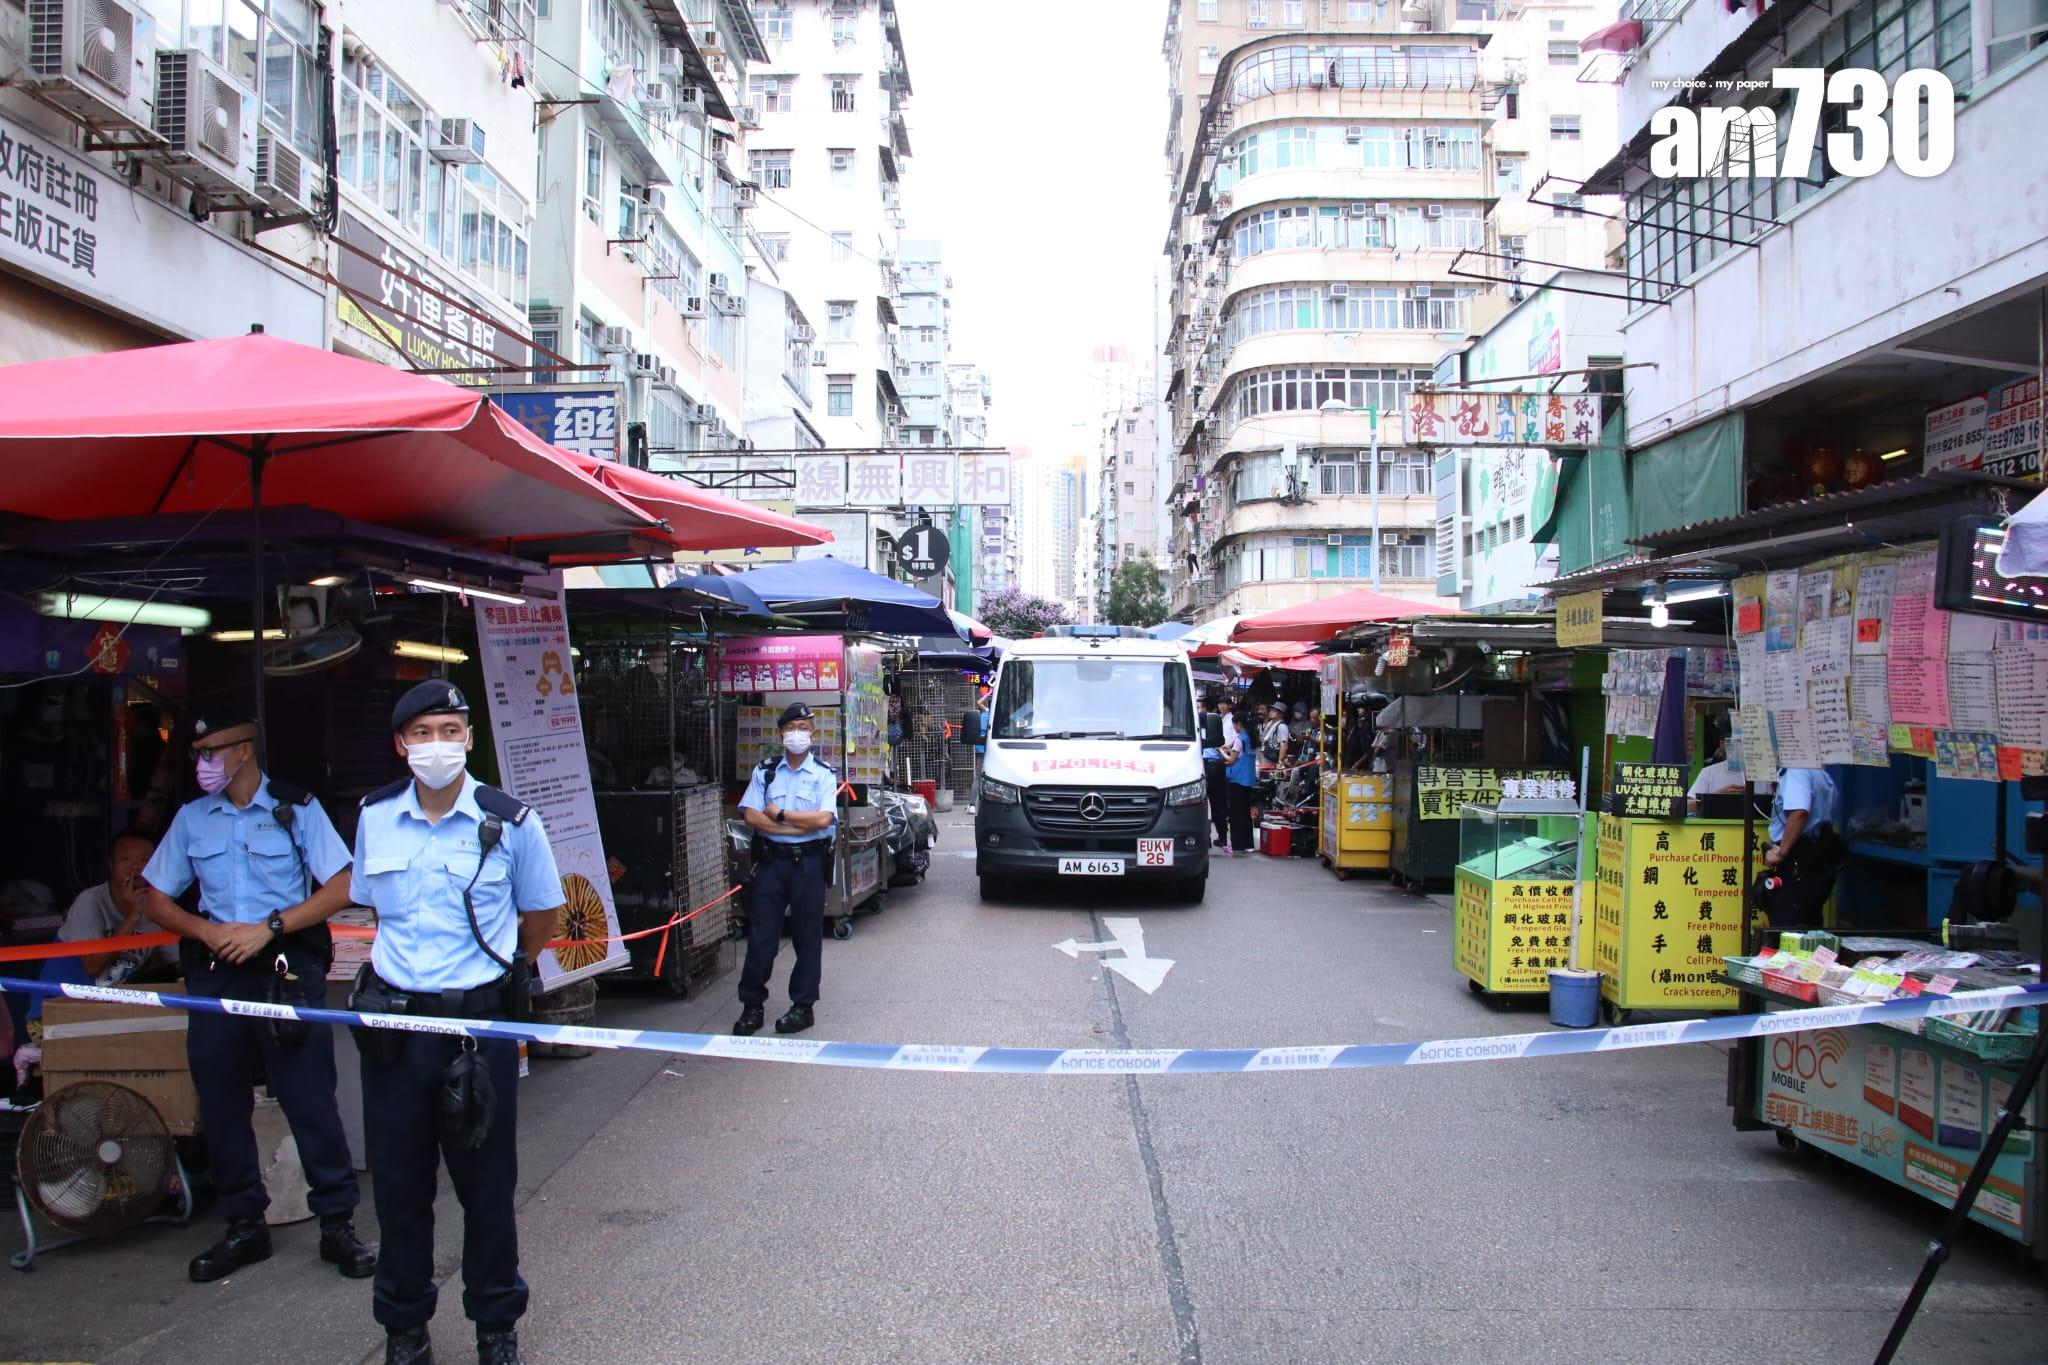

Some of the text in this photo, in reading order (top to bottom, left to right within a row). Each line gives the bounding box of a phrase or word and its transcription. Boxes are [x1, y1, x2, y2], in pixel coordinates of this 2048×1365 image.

[406, 331, 441, 367] LUCKY
[1058, 758, 1134, 770] POLICE
[1502, 779, 1576, 799] 專業維修
[1140, 841, 1171, 852] EUKW
[1147, 853, 1165, 865] 26
[1650, 853, 1691, 863] Purchase
[1692, 853, 1709, 863] Cell
[1711, 853, 1739, 863] Phone
[1064, 859, 1120, 873] AM 6163
[1693, 888, 1738, 899] Tempered
[1523, 903, 1552, 911] Highest
[1512, 925, 1551, 933] Tempered
[1687, 922, 1738, 931] Free Phone
[1687, 956, 1704, 965] Cell
[1664, 987, 1690, 997] Crack
[372, 1019, 411, 1031] POLICE
[1773, 1028, 1840, 1089] abc
[1771, 1071, 1806, 1094] MOBILE
